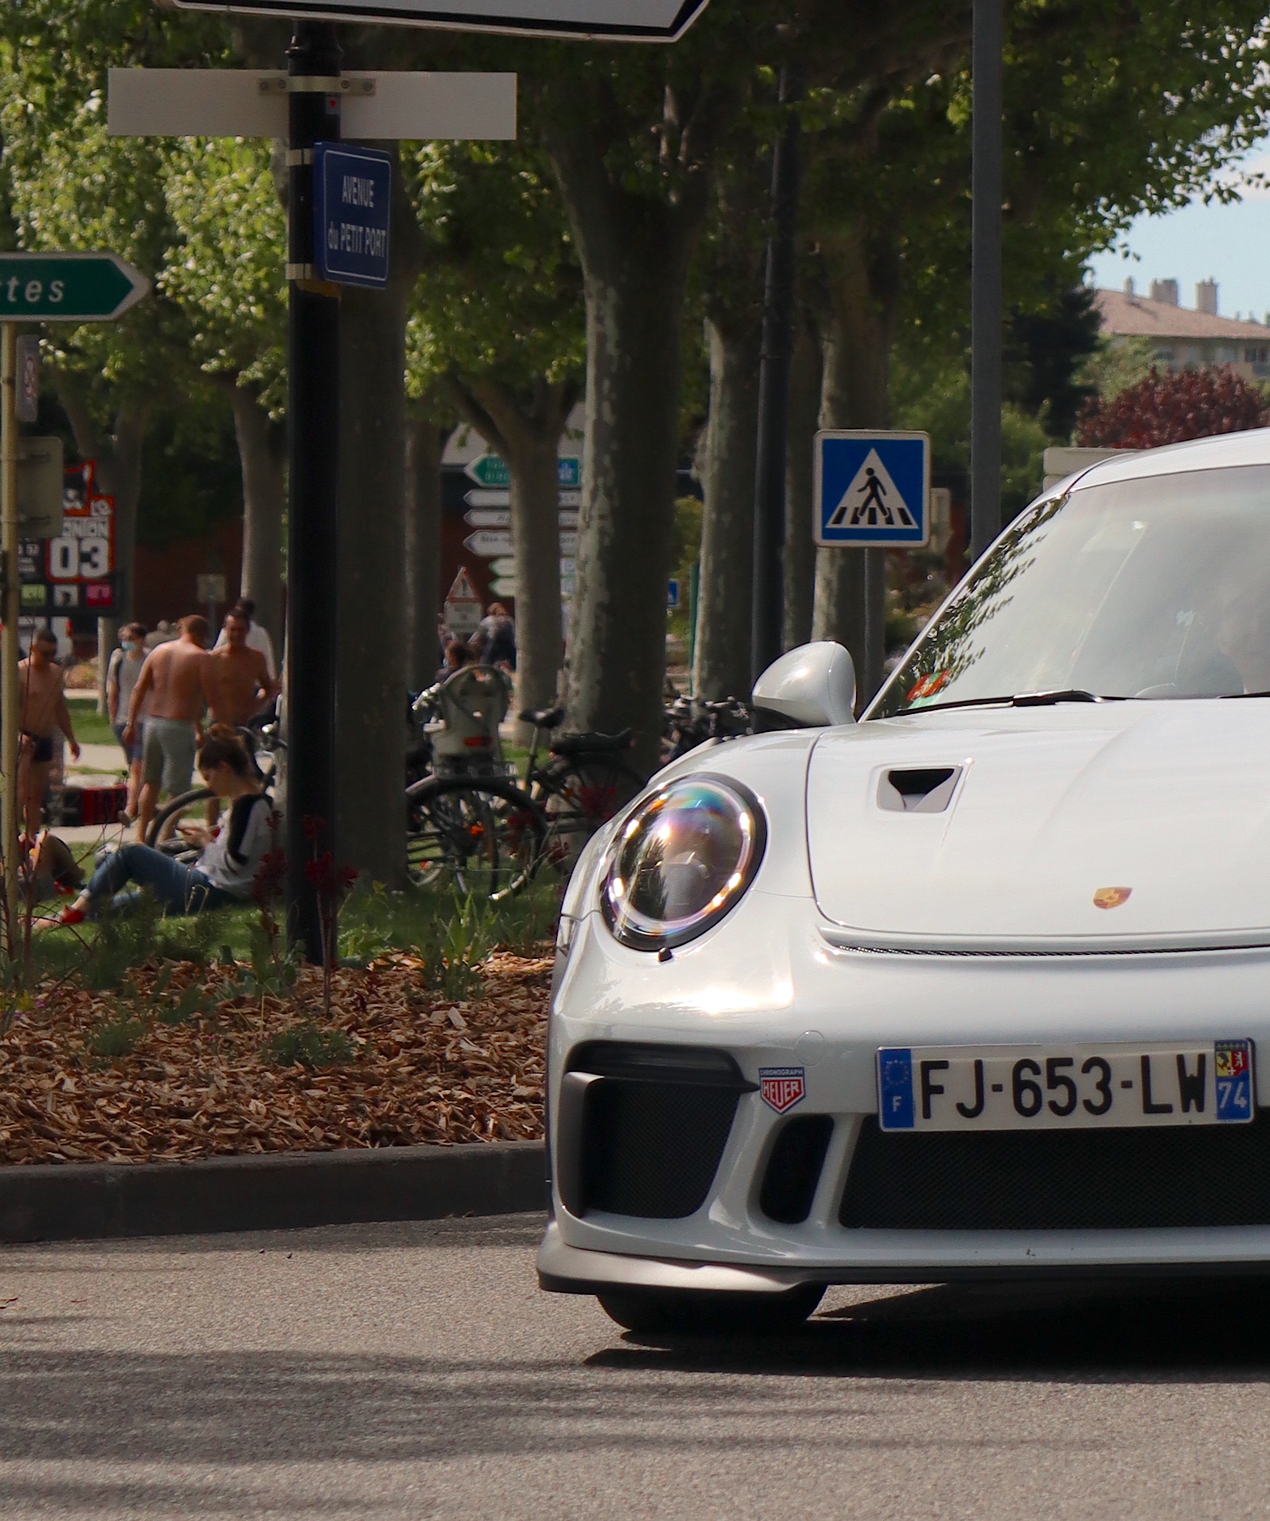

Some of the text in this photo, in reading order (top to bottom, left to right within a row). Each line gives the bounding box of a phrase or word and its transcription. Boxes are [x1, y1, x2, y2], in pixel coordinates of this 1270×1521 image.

[342, 175, 375, 208] AVENUE
[328, 221, 387, 258] du PETIT PORT
[0, 275, 65, 302] tes
[50, 536, 110, 579] 03
[763, 1080, 800, 1108] HEUER
[920, 1052, 1207, 1120] FJ-653-LW
[1217, 1080, 1247, 1109] 74
[892, 1095, 902, 1112] F
